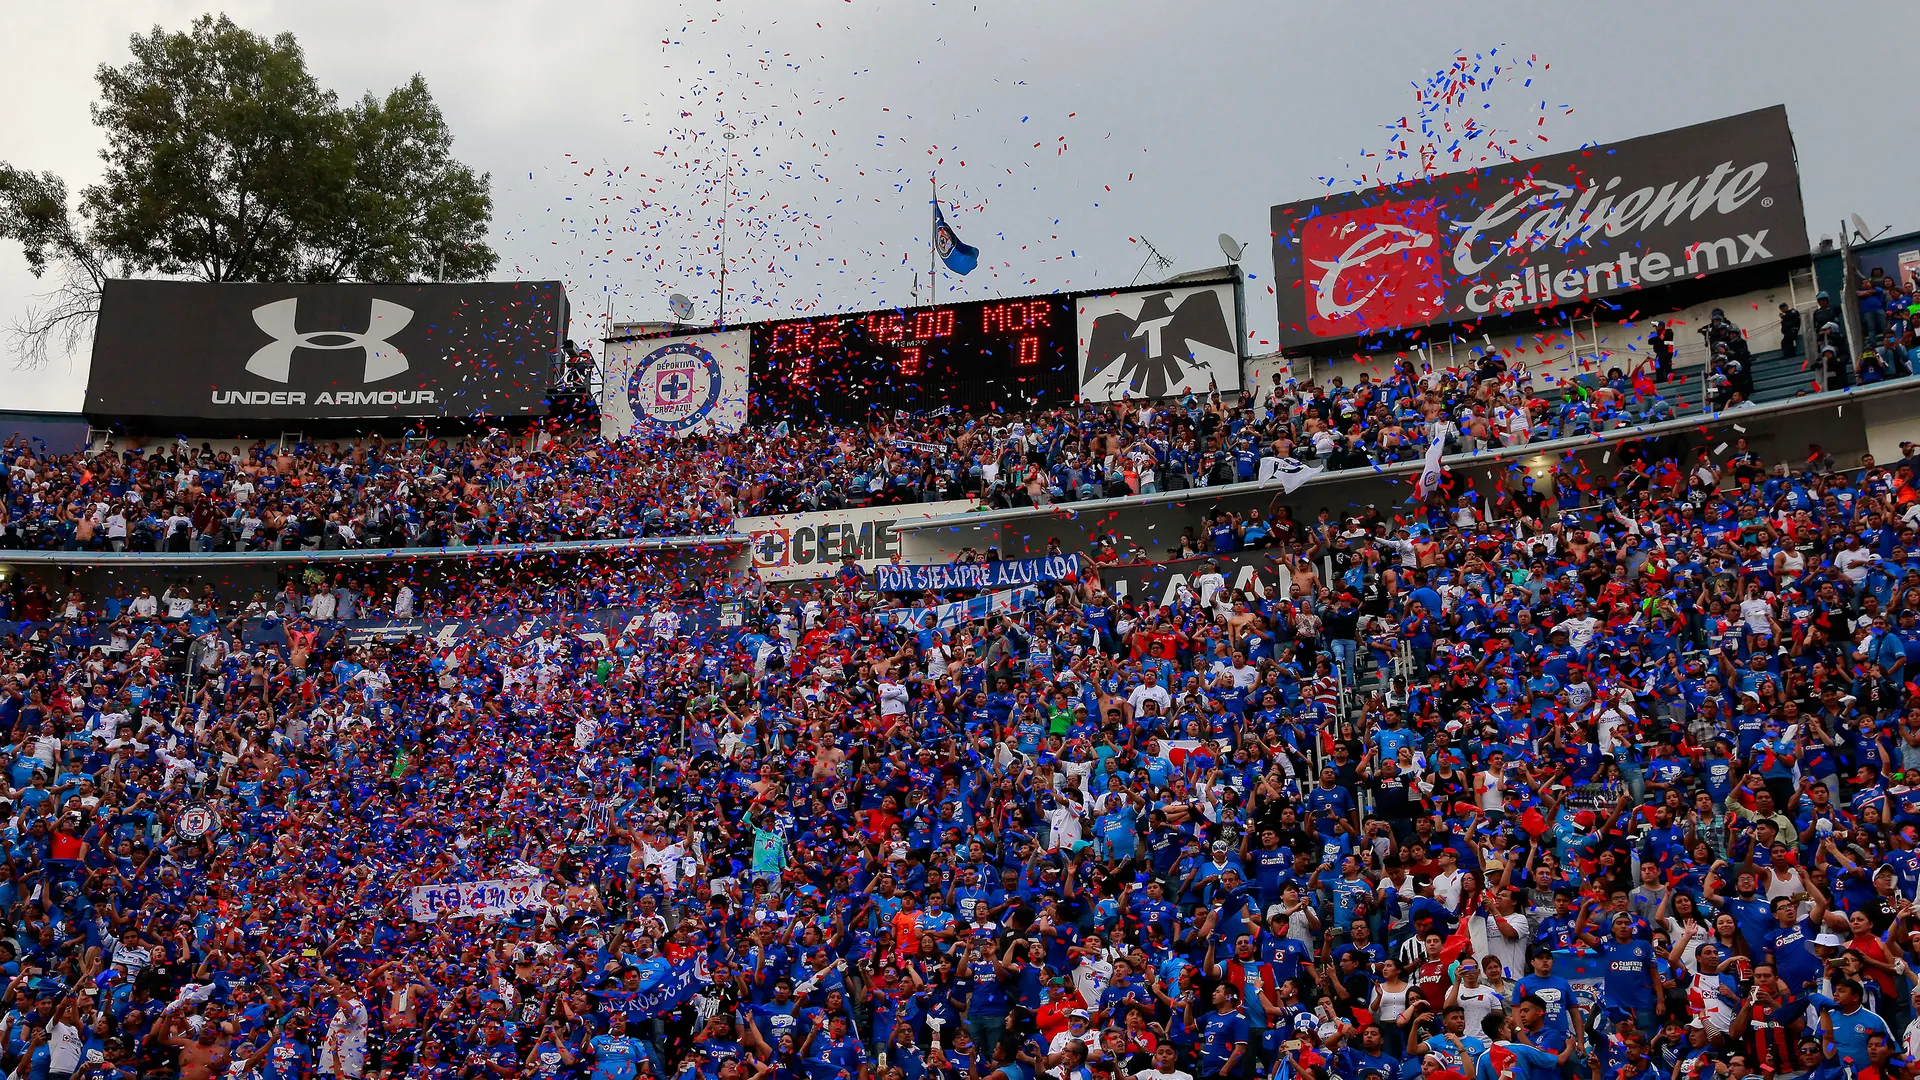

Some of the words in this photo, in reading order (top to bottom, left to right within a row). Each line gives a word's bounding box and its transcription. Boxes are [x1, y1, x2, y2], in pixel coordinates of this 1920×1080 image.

[1452, 160, 1768, 275] Caliente
[1465, 228, 1773, 314] caliente.mx
[772, 321, 840, 352] CRZ
[867, 310, 955, 342] 45:00
[983, 300, 1051, 333] MOR
[900, 348, 920, 375] 2
[1020, 336, 1038, 364] 0
[656, 360, 696, 371] DEPORTIVO
[211, 390, 307, 406] UNDER
[313, 390, 436, 406] ARMOUR
[654, 405, 675, 414] CRUZ
[674, 403, 693, 412] AZUL
[879, 566, 914, 592] POR
[916, 562, 994, 590] SIEMPRE
